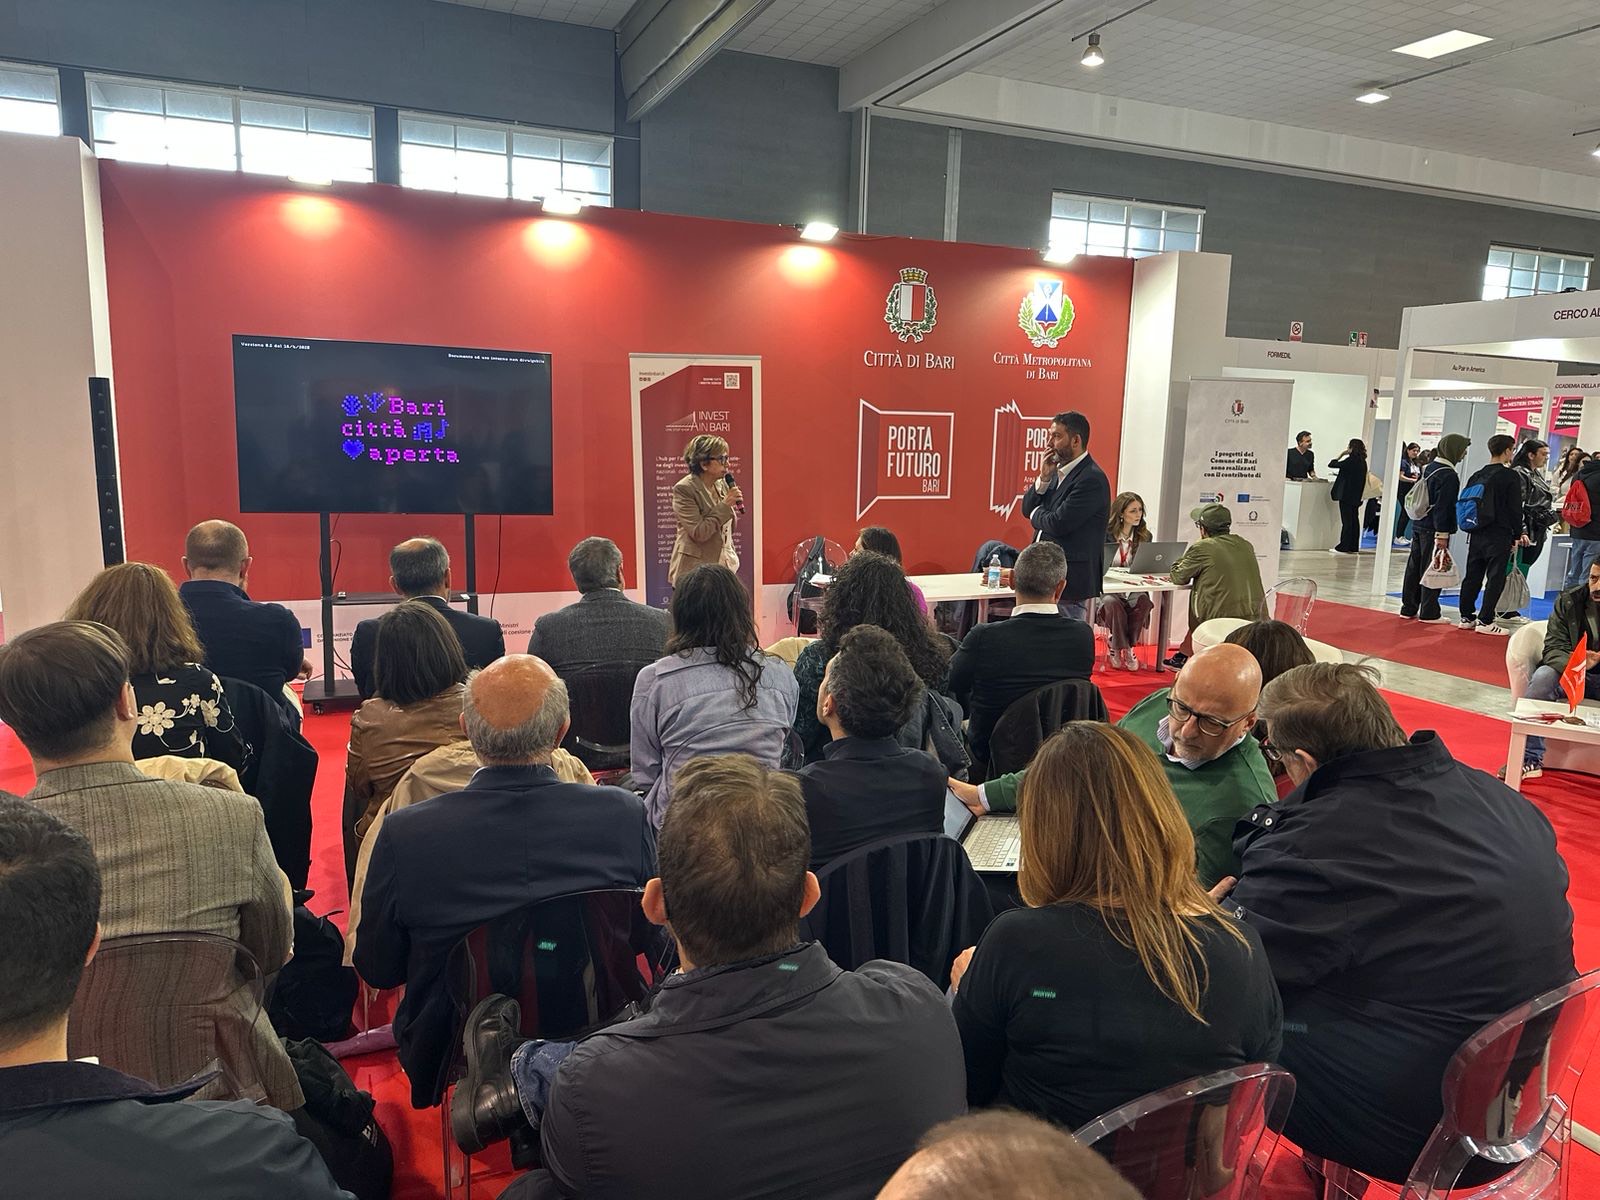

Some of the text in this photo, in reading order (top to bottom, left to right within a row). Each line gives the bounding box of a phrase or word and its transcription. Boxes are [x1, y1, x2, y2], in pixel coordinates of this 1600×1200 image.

[1554, 308, 1588, 320] CERCO
[864, 350, 955, 370] CITTÀ DI BARI
[994, 352, 1092, 368] CITTÀ METROPOLITANA
[1026, 368, 1059, 380] DI BARI
[388, 396, 446, 416] Bari
[699, 411, 730, 420] INVEST
[342, 419, 407, 438] città
[699, 422, 730, 432] IN BARI
[888, 426, 933, 450] PORTA
[1026, 428, 1051, 448] POR
[369, 448, 460, 465] aperta
[887, 452, 941, 478] FUTURO
[1024, 451, 1044, 471] FUT
[922, 479, 940, 493] BARI
